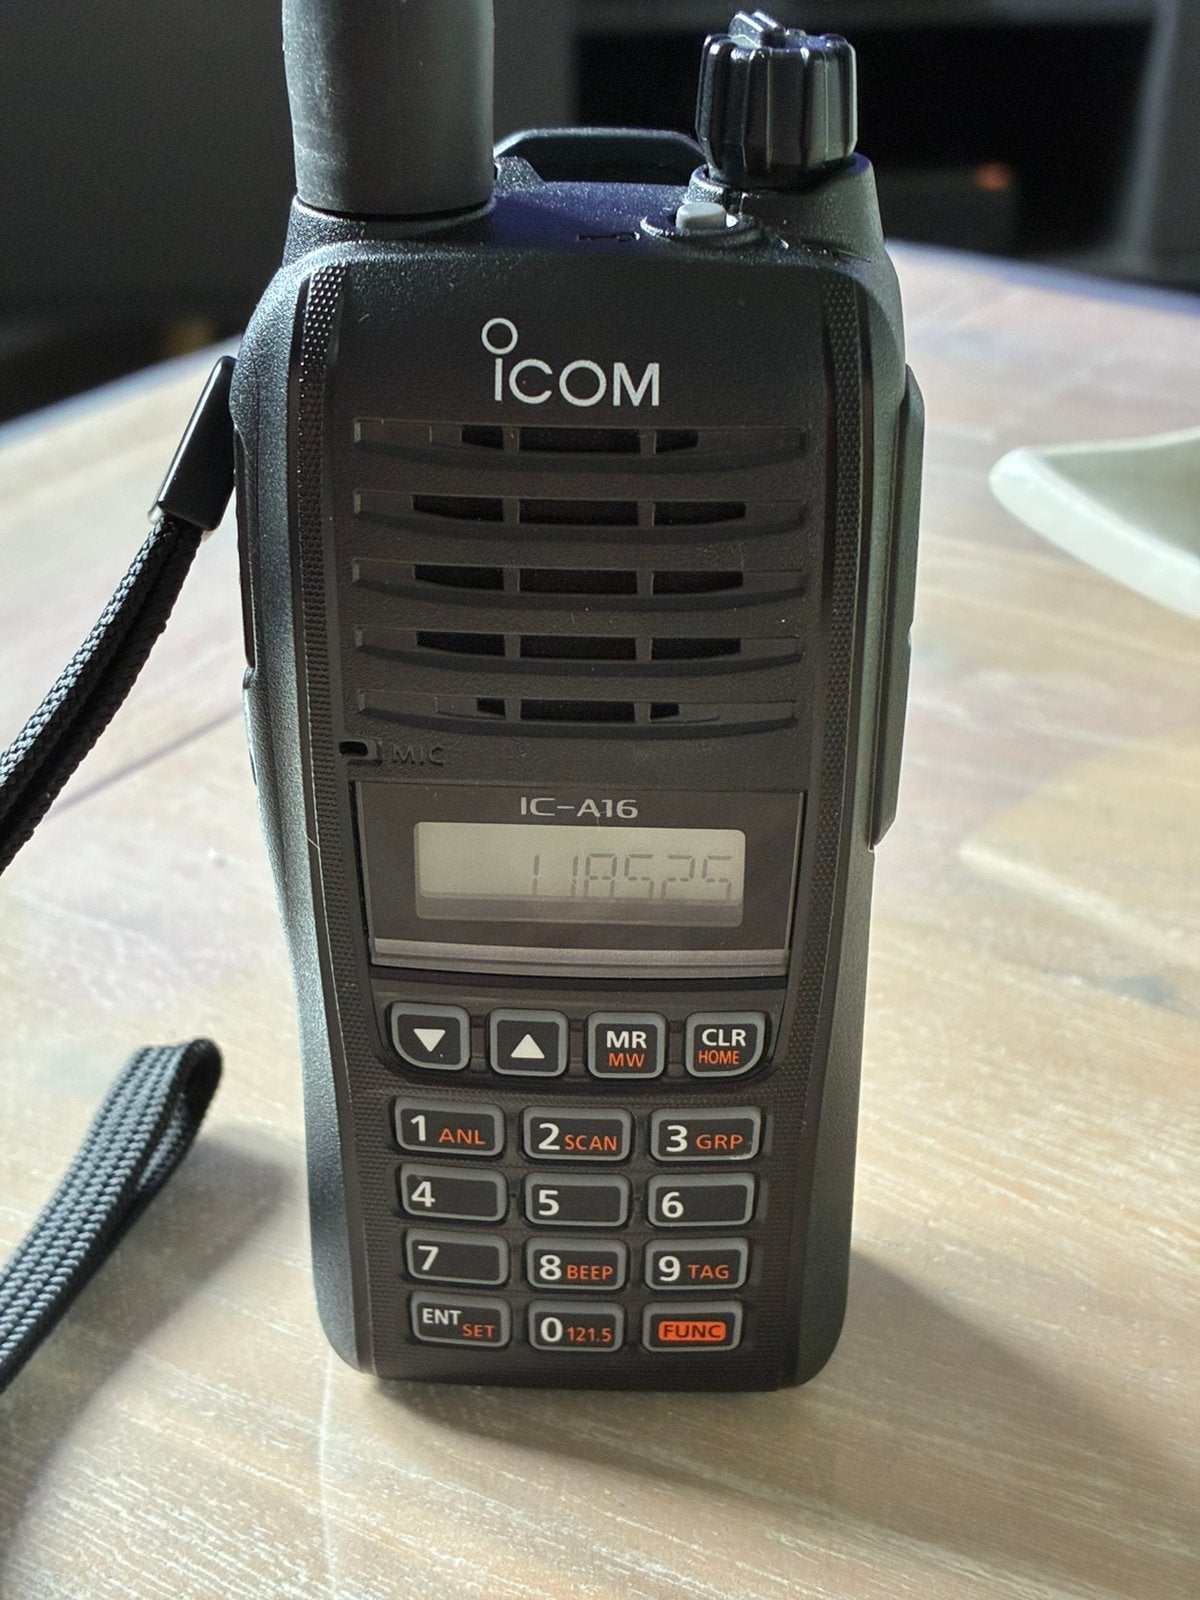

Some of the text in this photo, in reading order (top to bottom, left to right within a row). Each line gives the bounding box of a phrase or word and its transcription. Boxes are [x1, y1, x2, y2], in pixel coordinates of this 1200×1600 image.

[392, 742, 445, 765] MIC
[520, 797, 639, 819] IC-A16
[606, 1030, 647, 1049] MR
[701, 1028, 747, 1047] CLR
[608, 1053, 645, 1067] MW
[698, 1050, 740, 1065] HOME
[410, 1115, 486, 1145] 1 ANL
[538, 1123, 617, 1151] 2 SCAN
[665, 1125, 743, 1152] 3 GRP
[411, 1181, 435, 1208] 4
[538, 1190, 560, 1216] 5
[661, 1192, 684, 1218] 6
[418, 1246, 439, 1271] 7
[539, 1255, 613, 1280] 8 BEEP
[658, 1256, 729, 1281] 9 TAG
[422, 1309, 461, 1325] ENT
[540, 1317, 612, 1342] 0 121.5
[462, 1324, 495, 1338] SET
[663, 1325, 722, 1339] FUNC
